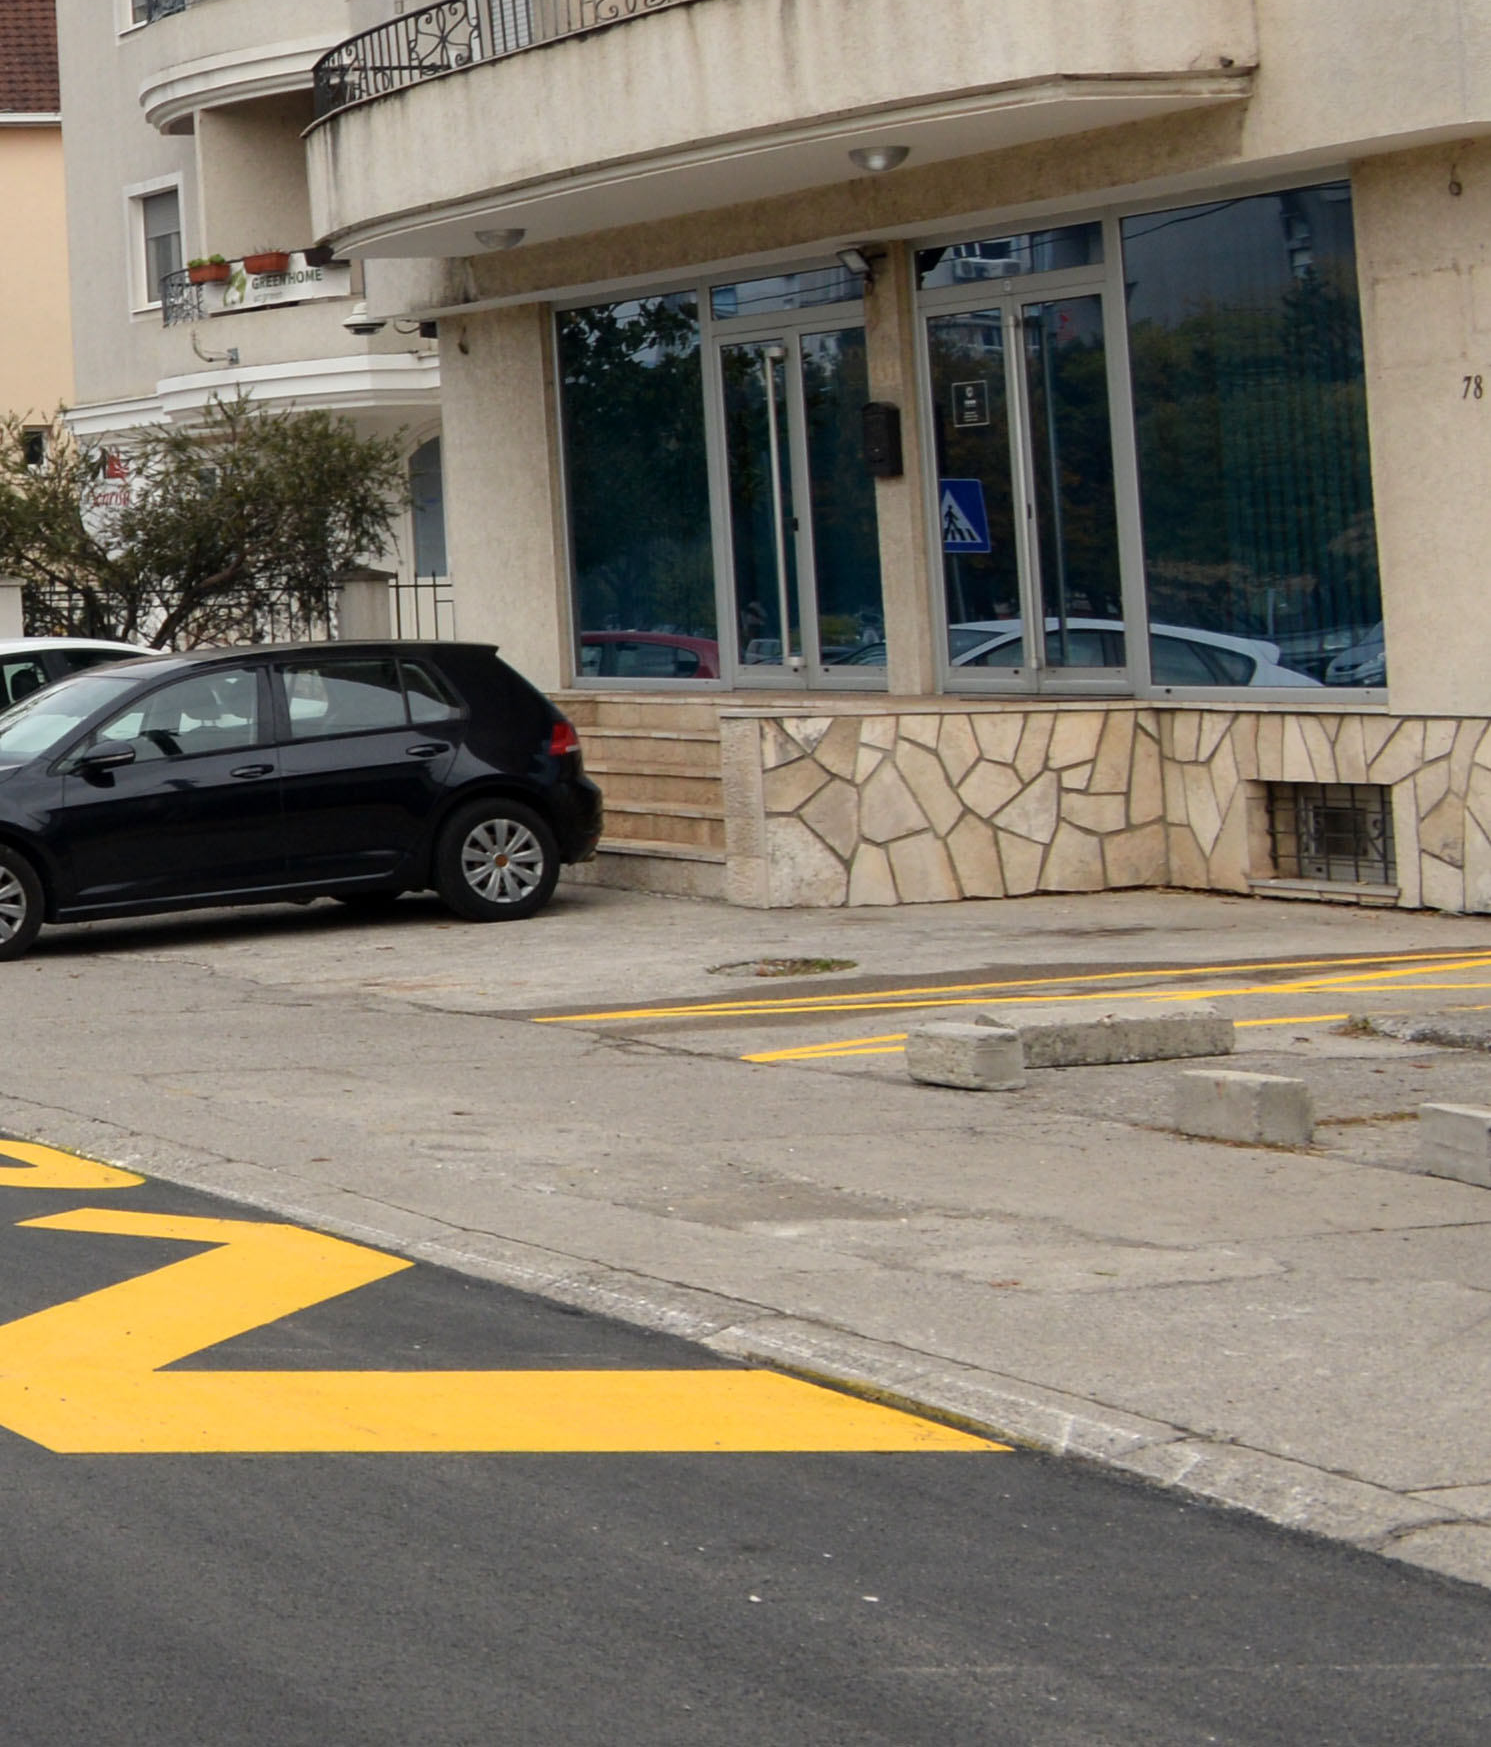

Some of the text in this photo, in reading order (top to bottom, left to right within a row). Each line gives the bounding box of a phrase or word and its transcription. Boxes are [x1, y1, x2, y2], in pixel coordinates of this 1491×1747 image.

[252, 269, 323, 289] GREEN HOME
[1463, 374, 1483, 400] 78
